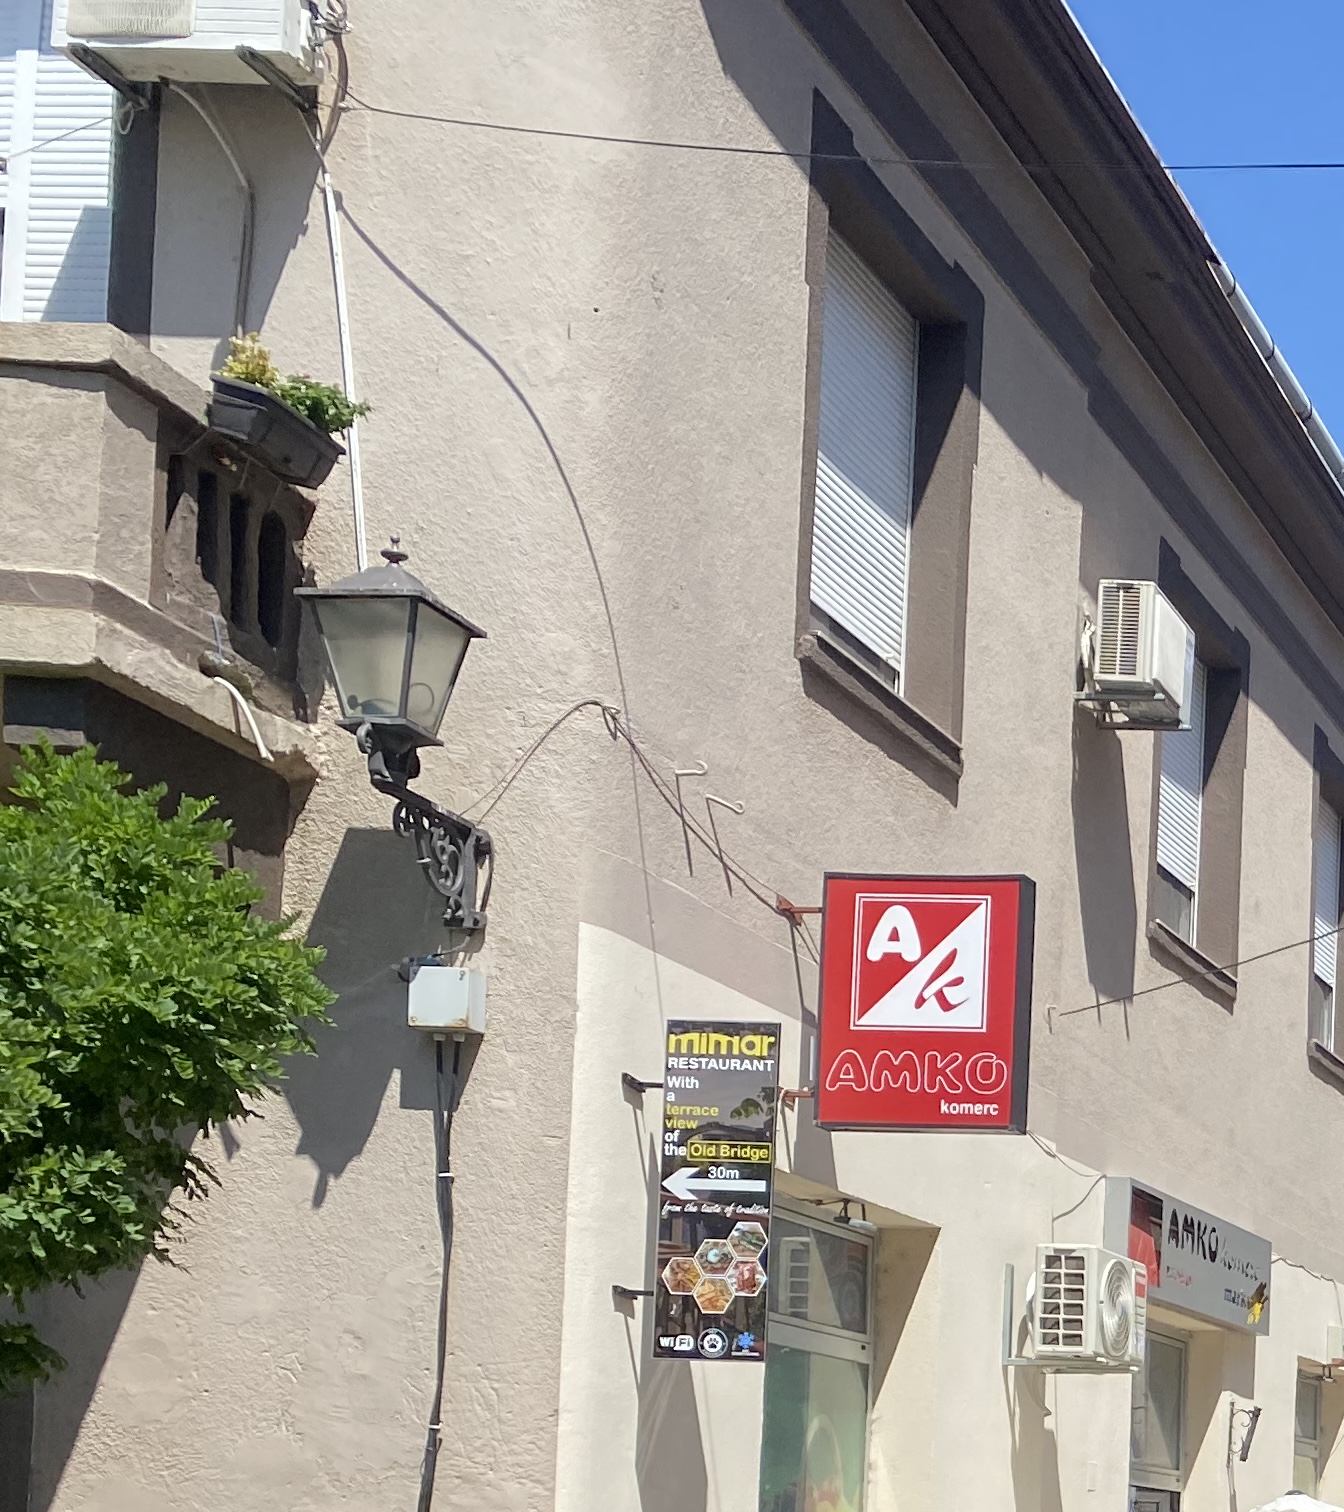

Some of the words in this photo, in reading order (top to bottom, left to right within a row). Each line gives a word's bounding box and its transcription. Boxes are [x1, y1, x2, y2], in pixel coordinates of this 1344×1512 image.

[866, 904, 922, 963] A
[667, 1032, 776, 1057] mimar
[667, 1056, 775, 1072] RESTAURANT
[826, 1048, 1008, 1095] AMKO
[667, 1075, 700, 1089] With
[666, 1091, 676, 1102] a
[666, 1104, 720, 1117] terrace
[940, 1099, 999, 1116] komerc
[665, 1118, 699, 1130] view
[664, 1129, 681, 1142] of
[664, 1144, 687, 1156] the
[691, 1143, 716, 1157] Old
[719, 1145, 770, 1161] Bridge
[707, 1165, 740, 1179] 30m
[1167, 1207, 1219, 1264] AMKO
